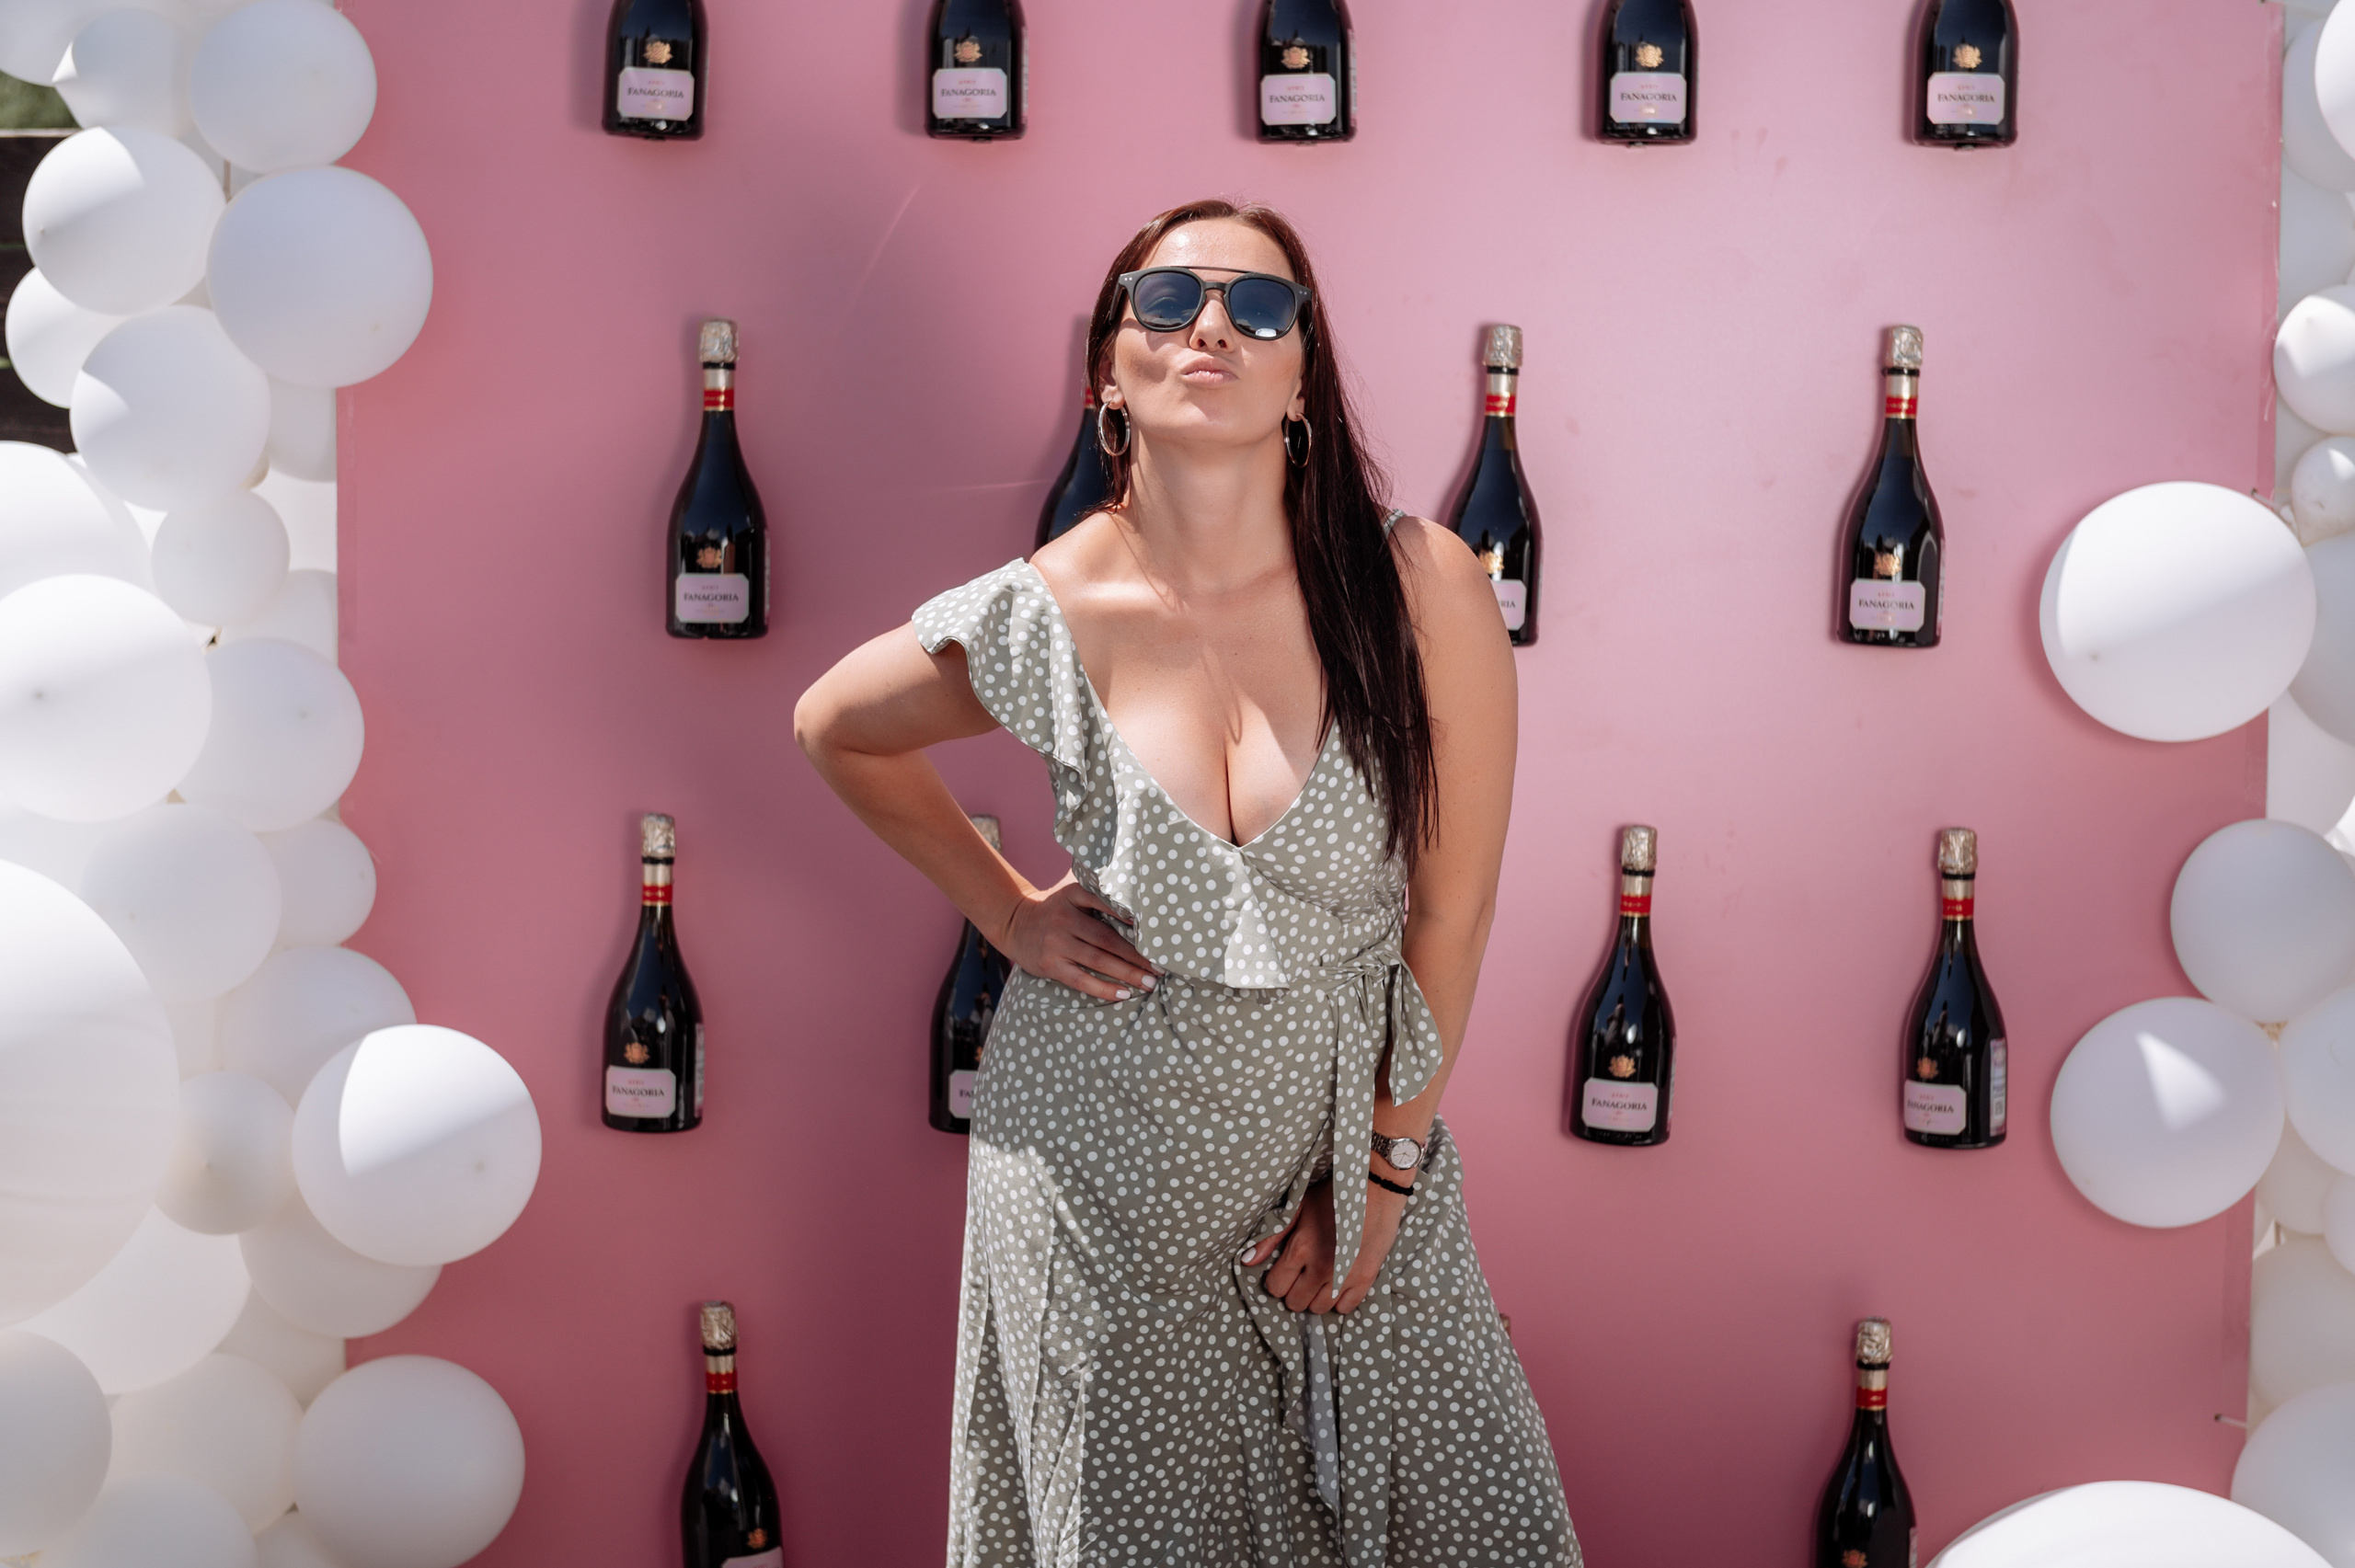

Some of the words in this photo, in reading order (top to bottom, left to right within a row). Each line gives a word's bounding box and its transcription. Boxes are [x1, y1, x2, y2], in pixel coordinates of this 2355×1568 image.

[627, 86, 684, 99] FANAGORIA
[940, 88, 997, 97] FANAGORIA
[1620, 93, 1678, 102] FANAGORIA
[1269, 94, 1326, 104] FANAGORIA
[1937, 93, 1995, 103] FANAGORIA
[684, 592, 740, 602] FANAGORIA
[1858, 600, 1914, 611] FANAGORIA
[612, 1085, 665, 1097] FANAGORIA
[1591, 1097, 1648, 1111] FANAGORIA
